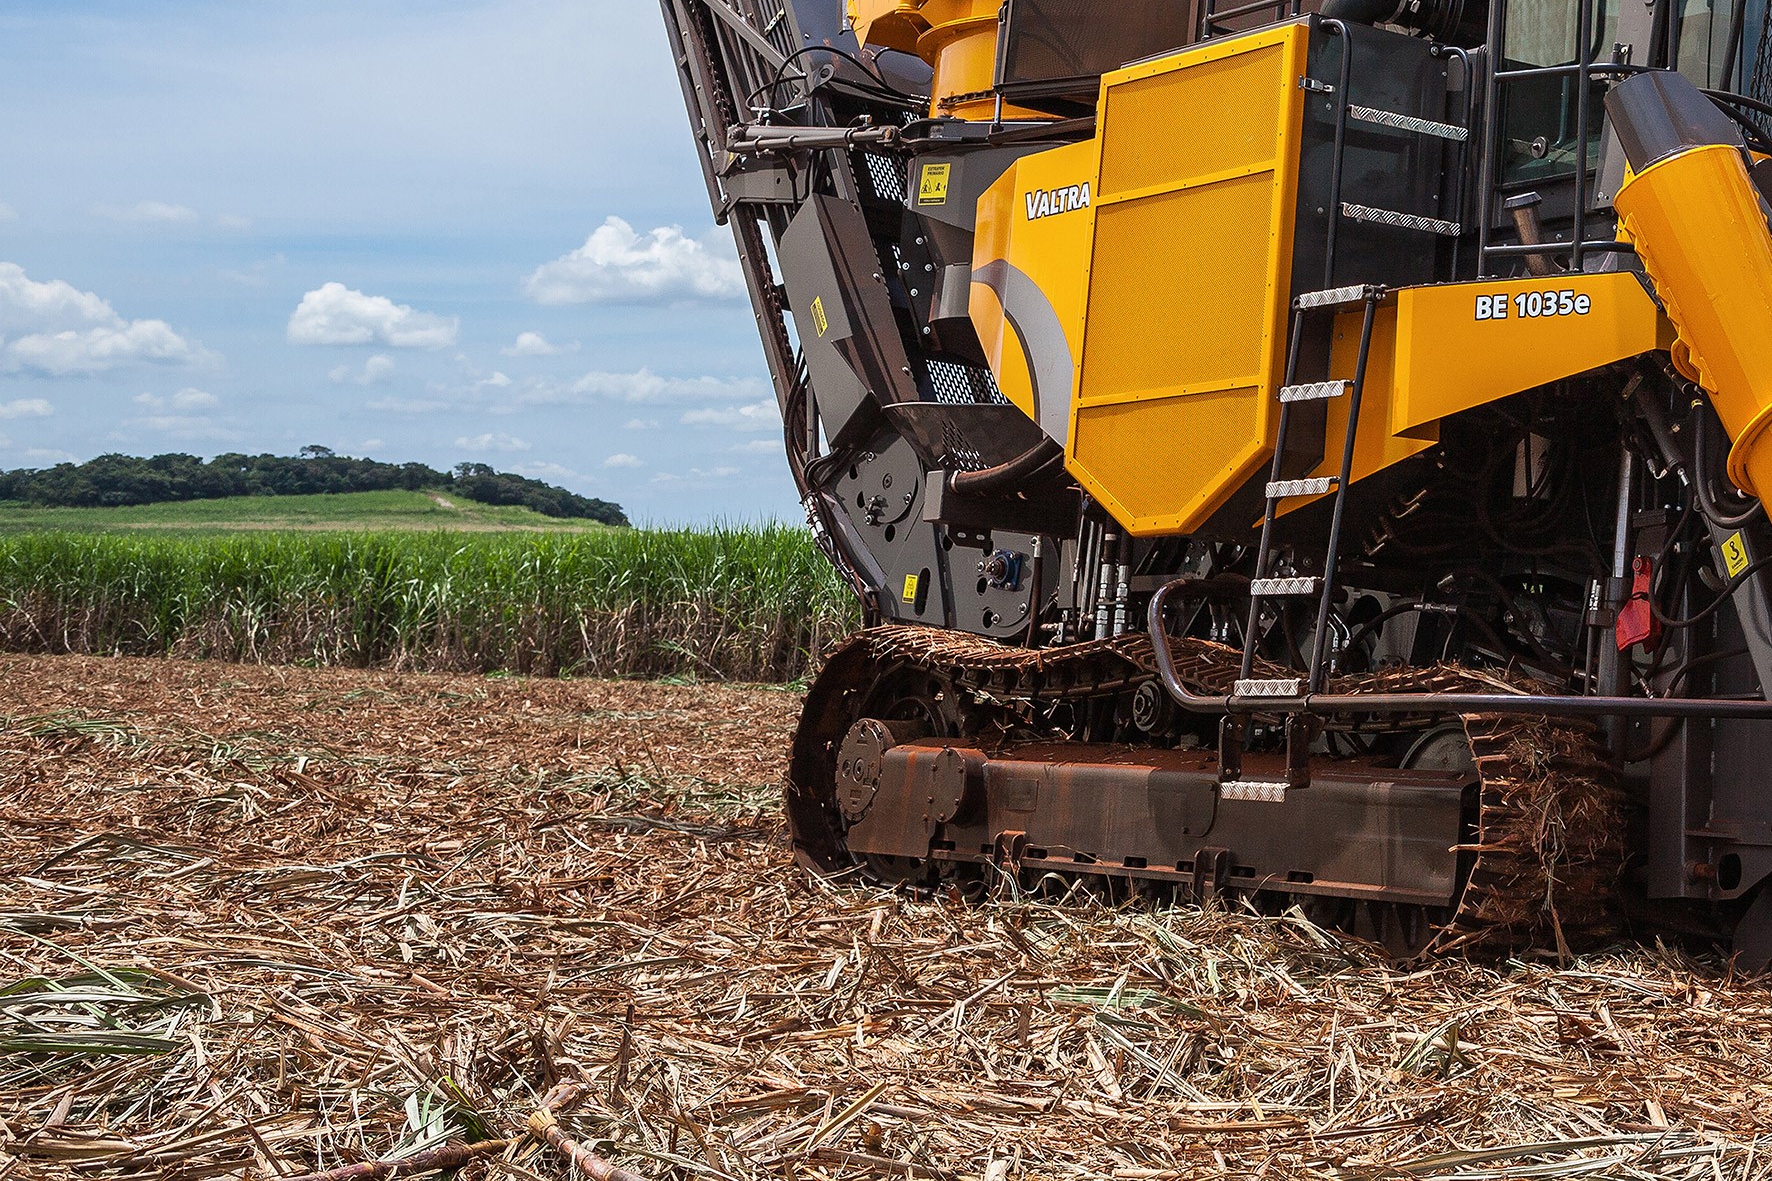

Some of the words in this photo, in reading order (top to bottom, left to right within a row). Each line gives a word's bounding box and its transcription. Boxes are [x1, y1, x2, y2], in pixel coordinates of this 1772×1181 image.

[1025, 182, 1091, 221] VALTRA
[1475, 294, 1508, 320] BE
[1514, 289, 1591, 318] 1035e
